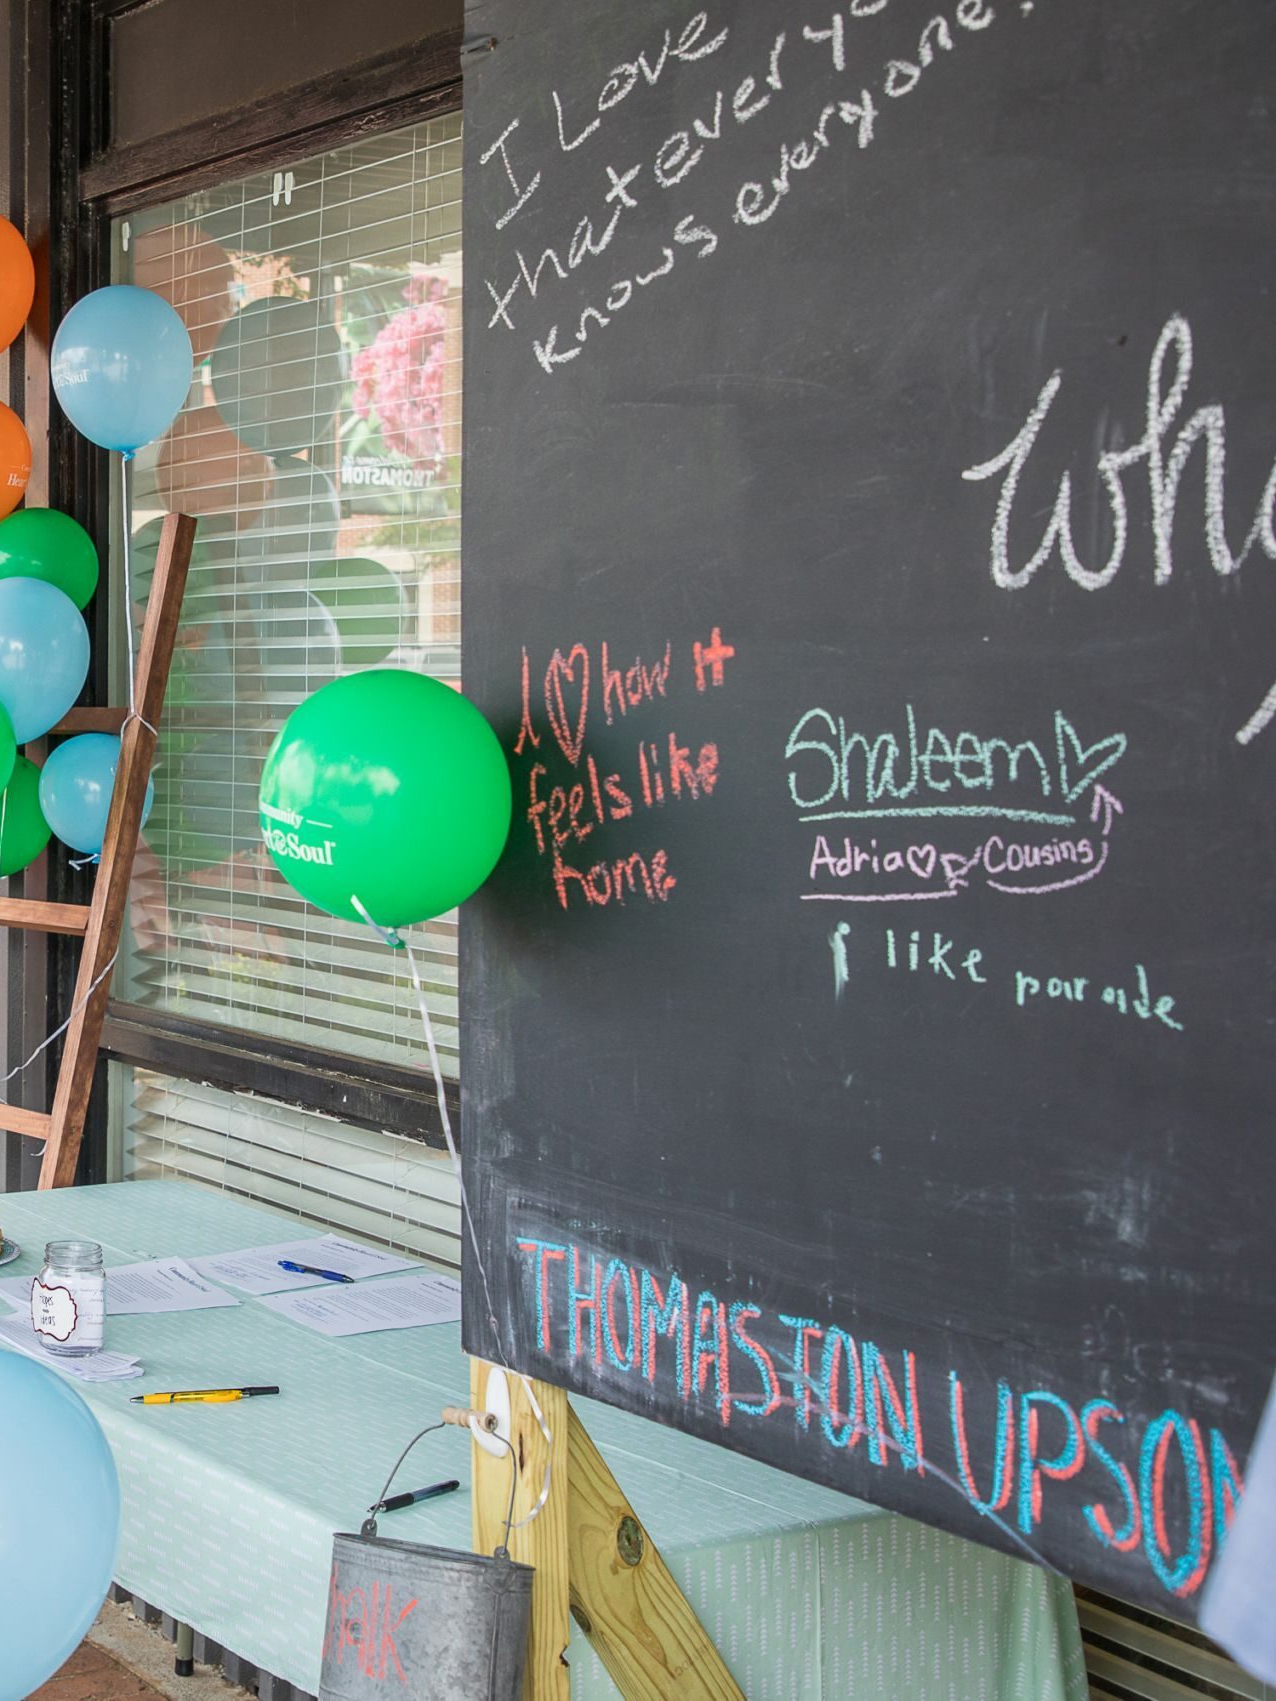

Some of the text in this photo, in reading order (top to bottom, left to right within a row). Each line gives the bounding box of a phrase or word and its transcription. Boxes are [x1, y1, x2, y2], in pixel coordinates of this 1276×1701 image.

[961, 311, 1276, 591] Wh
[602, 639, 670, 726] how
[638, 730, 720, 808] like
[286, 832, 335, 866] Soul
[552, 838, 677, 911] home
[810, 834, 1094, 879] Adria Cousins
[886, 929, 987, 983] like
[322, 1561, 420, 1690] halk
